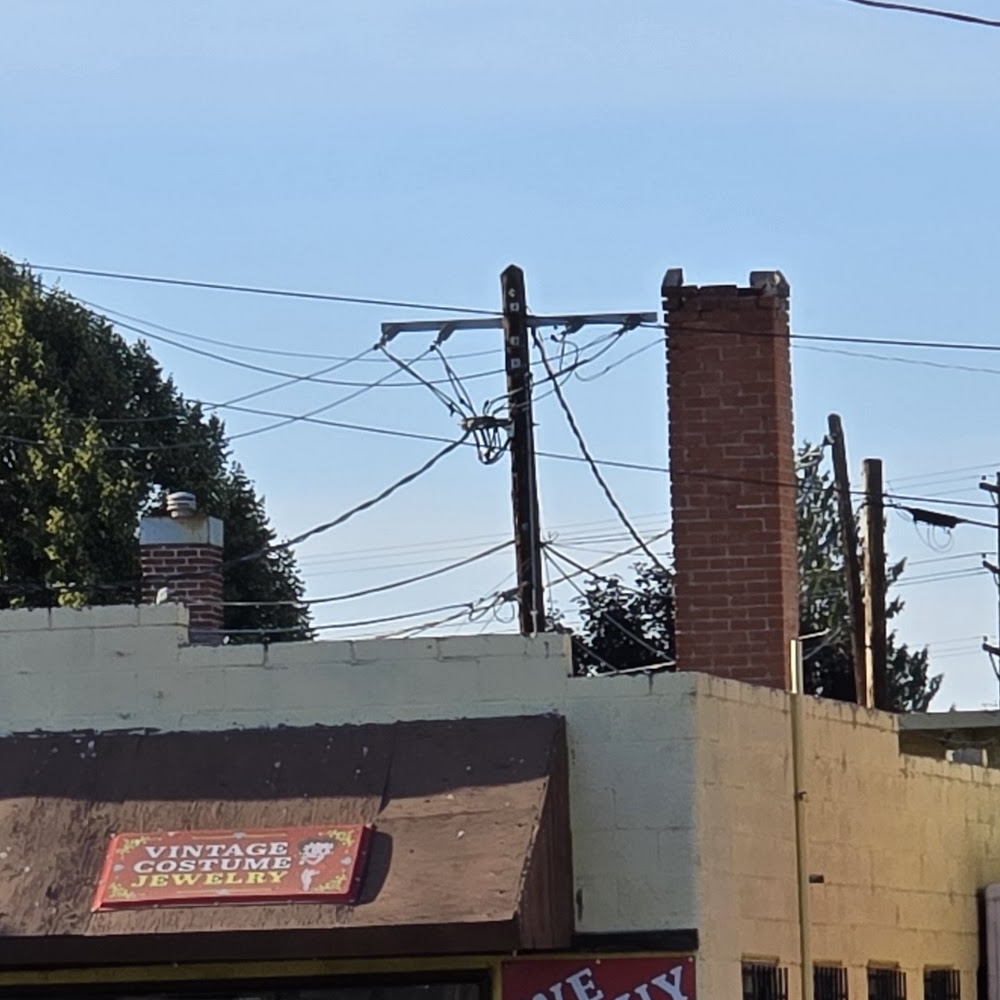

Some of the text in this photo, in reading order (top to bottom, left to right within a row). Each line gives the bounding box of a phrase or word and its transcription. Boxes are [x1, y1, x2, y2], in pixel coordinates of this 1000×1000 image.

[145, 842, 289, 859] VINTAGE
[133, 857, 292, 873] COSTUME
[131, 871, 289, 887] JEWELRY
